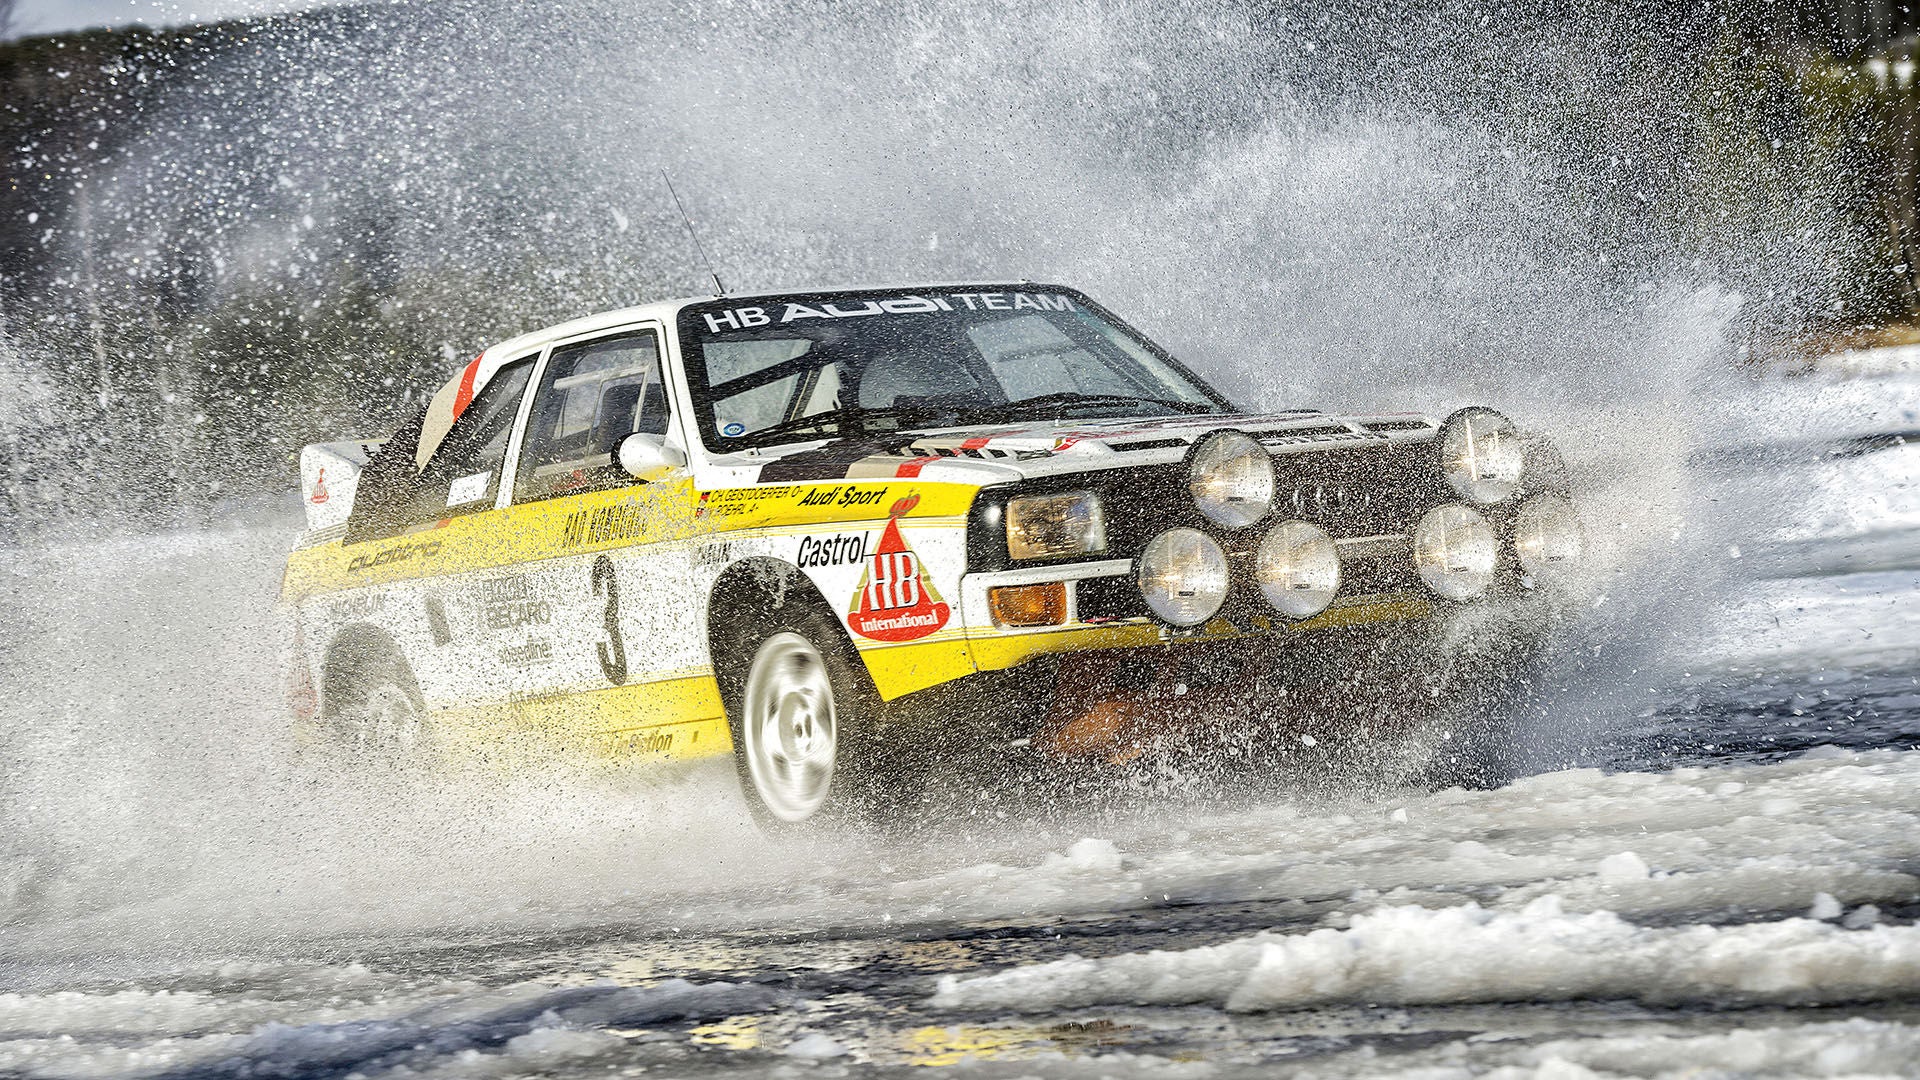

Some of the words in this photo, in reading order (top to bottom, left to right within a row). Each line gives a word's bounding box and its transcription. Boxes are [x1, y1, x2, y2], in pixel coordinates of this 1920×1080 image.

[702, 305, 772, 334] HB
[949, 293, 1078, 313] TEAM
[797, 486, 843, 507] Audi
[837, 485, 889, 508] Sport
[347, 540, 442, 573] quattro
[797, 530, 869, 569] Castrol
[863, 550, 921, 612] HB
[486, 600, 552, 630] RECARO
[591, 553, 628, 687] 3
[859, 609, 940, 633] international
